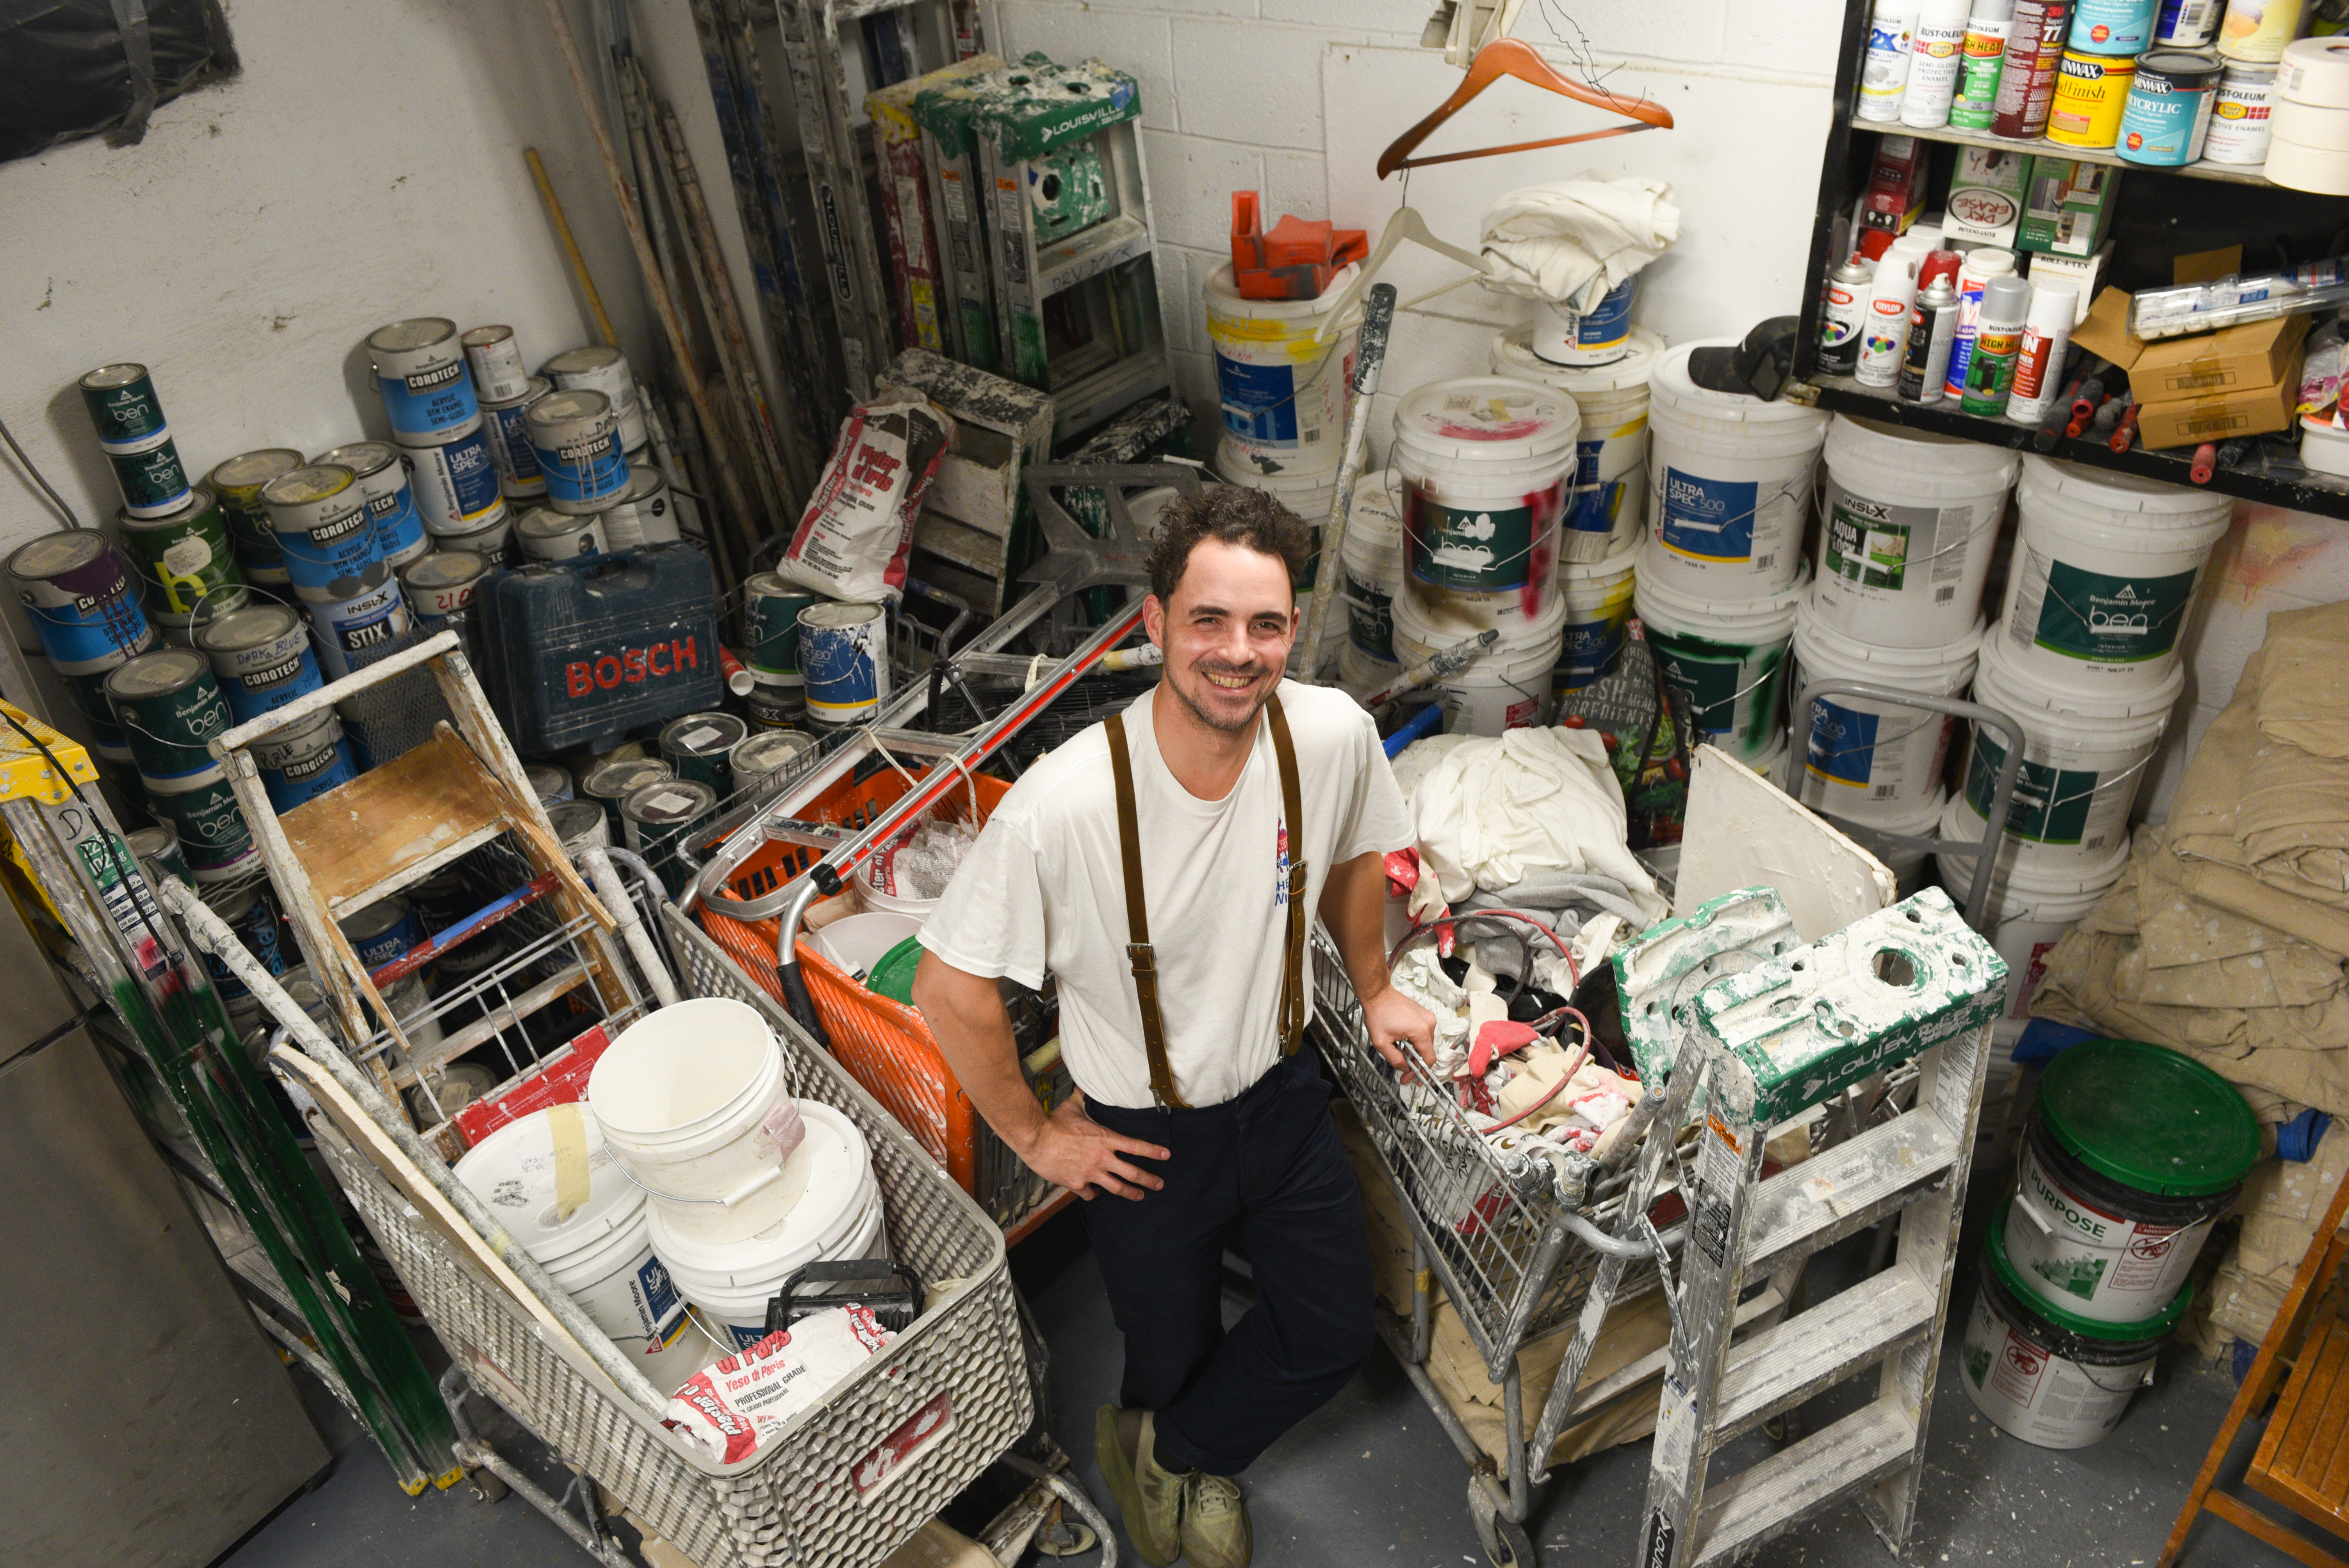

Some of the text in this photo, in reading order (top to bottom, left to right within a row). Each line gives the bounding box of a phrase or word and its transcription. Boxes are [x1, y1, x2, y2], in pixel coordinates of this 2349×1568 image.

[1870, 28, 1899, 51] 2X
[2044, 25, 2062, 42] 77
[1978, 41, 2002, 53] HEAT
[2068, 82, 2106, 100] Finish
[2235, 124, 2265, 132] ENAMEL
[1957, 198, 2010, 215] ERASE
[1965, 210, 1996, 224] DRY
[1875, 301, 1902, 313] KRYLON
[1981, 338, 2004, 349] HIGH
[408, 363, 460, 387] COROTECH
[426, 401, 464, 417] DTM ENAMEL
[431, 394, 456, 406] ACRYLIC
[112, 404, 149, 421] ben
[430, 409, 466, 426] SEMI-GLOSS
[449, 444, 483, 462] ULTRA
[149, 464, 179, 483] ben
[452, 458, 480, 474] SPEC
[433, 451, 455, 511] Benjamin Moore
[1670, 476, 1705, 499] ULTRA
[1669, 488, 1725, 511] SPEC 500
[1844, 495, 1890, 520] INSL-X
[312, 509, 365, 541] COROTECH
[1834, 517, 1857, 543] AQUA
[338, 542, 362, 558] ACRYLIC
[346, 590, 389, 615] INSL-X
[2089, 594, 2128, 606] Benjamin
[2089, 605, 2148, 626] ben
[348, 623, 387, 649] STIX
[1562, 631, 1591, 641] LTRA
[236, 631, 302, 665] DARK BLUE
[244, 656, 299, 687] COROTECH
[565, 636, 697, 698] BOSCH
[270, 689, 298, 704] ACRYLIC
[175, 697, 208, 719] Benjamin
[186, 701, 227, 736] ben
[1825, 721, 1846, 737] 500
[285, 745, 335, 777] COROTECH
[312, 776, 334, 793] ACRYLIC
[186, 802, 223, 820] Benjamin
[105, 894, 113, 903] 5ft
[112, 904, 128, 916] 9ft 5in
[2031, 1168, 2107, 1239] PURPOSE
[629, 1280, 645, 1309] Moore
[725, 1359, 786, 1393] Yeso de Paris
[734, 1364, 807, 1407] PROFESSIONAL GRADE
[746, 1388, 790, 1413] GRADO PROFESIONAL
[692, 1395, 743, 1436] Plaster
